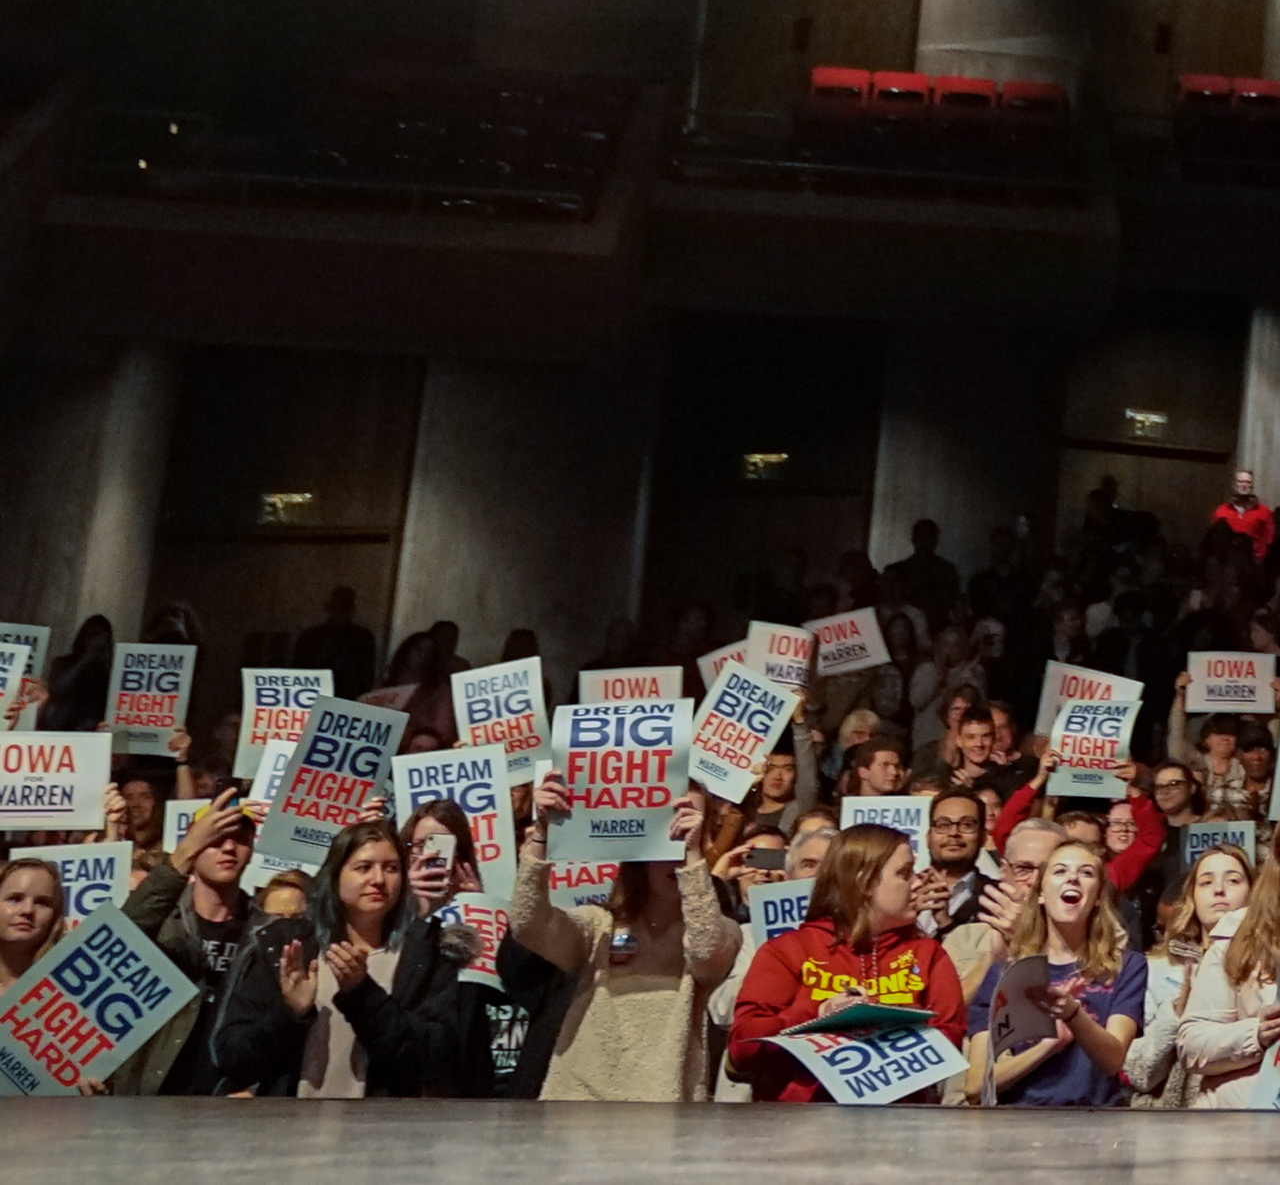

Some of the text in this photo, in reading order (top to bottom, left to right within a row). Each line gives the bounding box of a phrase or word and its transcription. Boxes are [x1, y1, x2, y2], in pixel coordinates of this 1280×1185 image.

[770, 635, 810, 657] IOW
[817, 621, 862, 645] IOWA
[125, 654, 183, 670] DREAM
[822, 644, 869, 664] WARREN
[121, 672, 180, 693] BIG
[256, 676, 321, 688] DREAM
[1207, 661, 1257, 679] IOWA
[465, 671, 529, 699] DREAM
[604, 678, 660, 700] IOWA
[726, 673, 785, 716] DREAM
[1059, 675, 1114, 701] IOWA
[1207, 685, 1256, 698] WARREN
[117, 694, 179, 714] FIGHT
[256, 689, 321, 709] BIG
[467, 690, 533, 725] BIG
[573, 705, 675, 717] DREAM
[1071, 705, 1129, 718] DREAM
[115, 715, 175, 727] HARD
[254, 709, 311, 729] FIGH
[714, 690, 775, 738] BIG
[318, 712, 392, 746] DREAM
[470, 714, 536, 746] FIGHT
[570, 715, 673, 749] BIG
[702, 714, 764, 756] FIGHT
[1064, 716, 1123, 739] BIG
[304, 736, 384, 779] BIG
[506, 737, 542, 754] RD
[693, 730, 751, 770] HARD
[1060, 736, 1120, 757] FIGHT
[0, 746, 75, 774] OWA
[568, 751, 673, 785] FIGHT
[1059, 758, 1119, 770] HARD
[409, 760, 493, 789] DREAM
[290, 768, 375, 809] FIGHT
[567, 788, 673, 809] HARD
[282, 796, 365, 827] HARD
[854, 809, 921, 827] DREAM
[591, 820, 646, 834] WARREN
[1191, 832, 1245, 848] DREAM
[63, 858, 115, 883] EAM
[64, 884, 112, 918] IG
[764, 897, 809, 926] DRE
[463, 904, 497, 976] FIGHT
[84, 924, 173, 1011] DREAM
[51, 948, 144, 1042] BIG
[21, 978, 115, 1066] FIGHT
[0, 1007, 81, 1087] HARD
[0, 1048, 40, 1092] WARREN
[845, 1045, 945, 1099] DREAM
